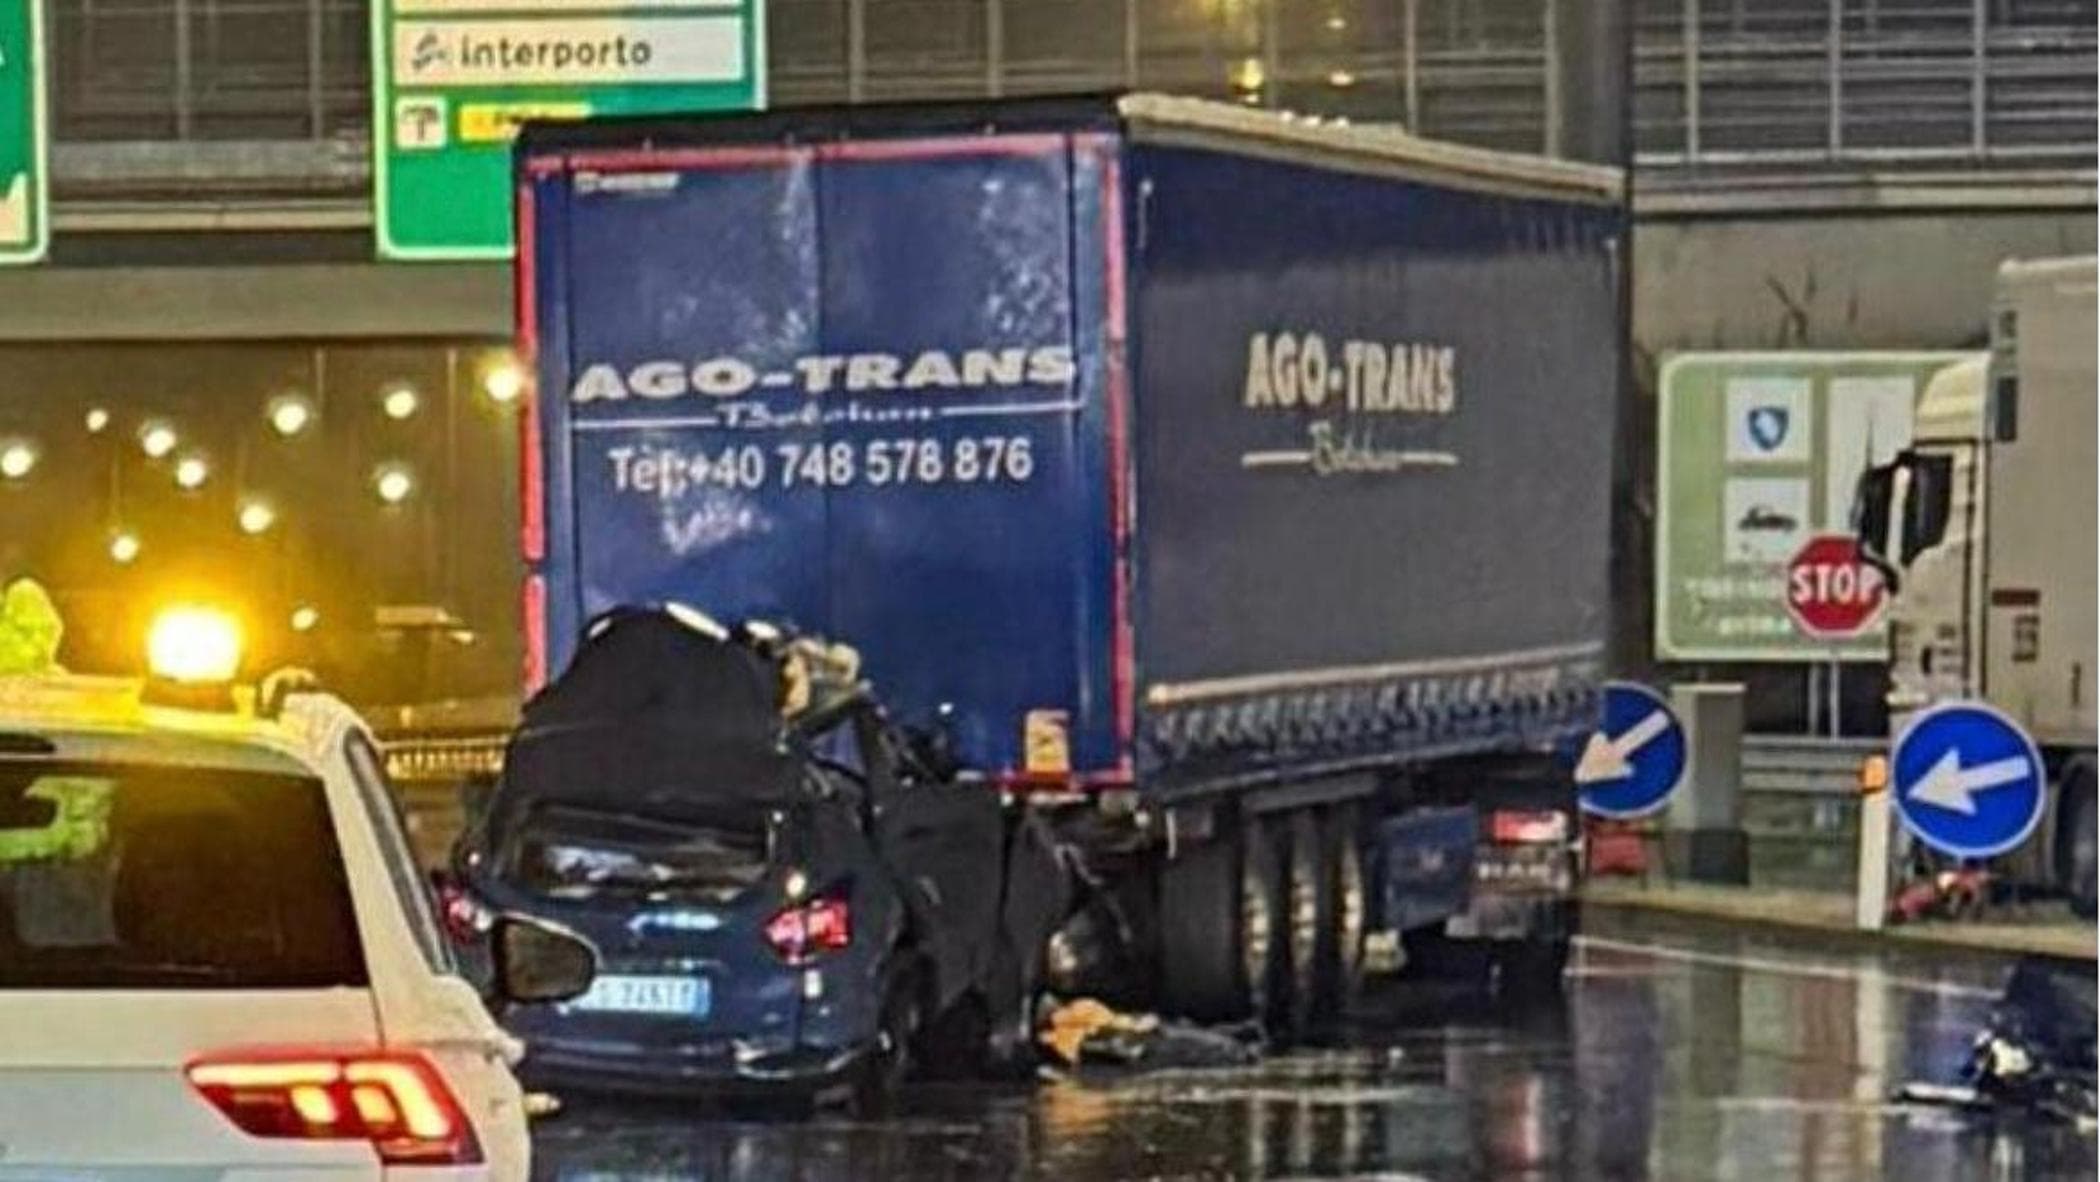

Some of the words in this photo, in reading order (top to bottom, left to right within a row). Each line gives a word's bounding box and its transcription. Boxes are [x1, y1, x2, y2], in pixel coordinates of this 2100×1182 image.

[460, 34, 651, 68] interporto
[573, 345, 1076, 400] AGO-TRANS
[1245, 332, 1455, 412] AGO-TRANS
[778, 442, 855, 488] 748
[867, 440, 943, 485] 578
[954, 437, 1034, 481] 876
[1791, 563, 1882, 603] STOP
